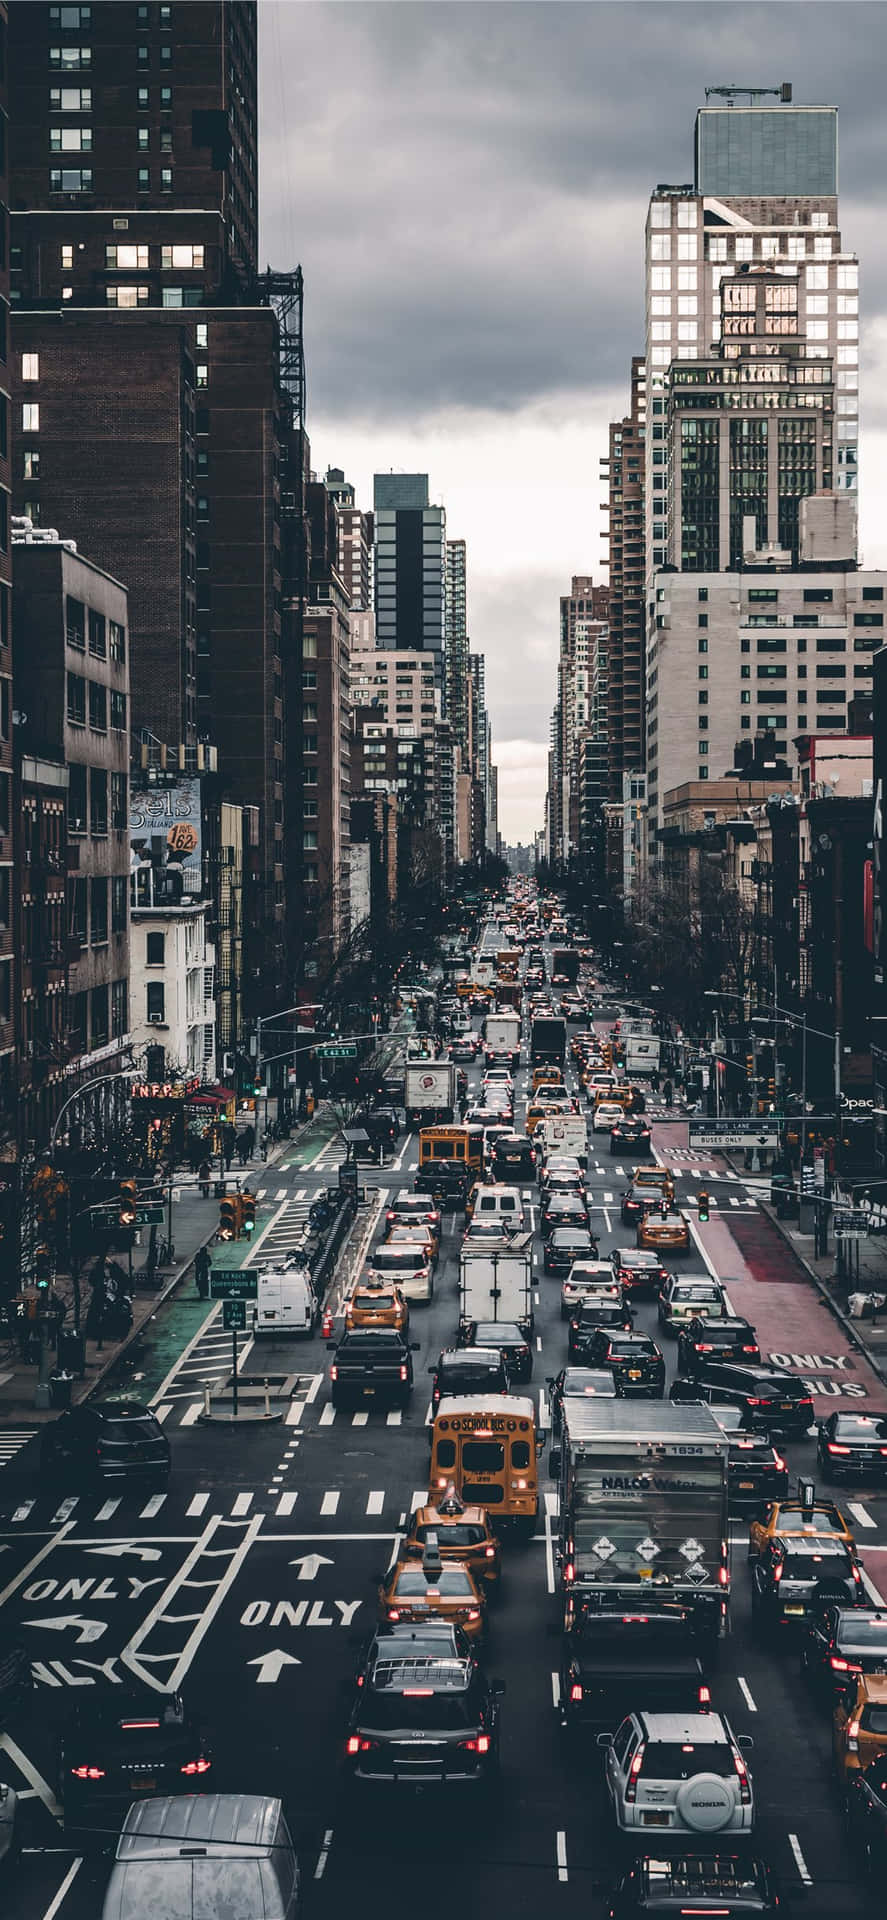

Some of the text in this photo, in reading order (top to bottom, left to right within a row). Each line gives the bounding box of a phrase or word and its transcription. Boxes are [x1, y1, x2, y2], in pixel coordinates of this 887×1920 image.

[171, 824, 193, 844] 1 AVE
[176, 834, 193, 849] 62
[769, 1353, 846, 1369] ONLY
[803, 1380, 867, 1397] BUS
[461, 1418, 505, 1432] SCHOOL BUS
[601, 1477, 697, 1490] NALCO Water
[22, 1577, 168, 1601] ONLY
[240, 1600, 363, 1626] ONLY
[31, 1657, 124, 1689] NLY
